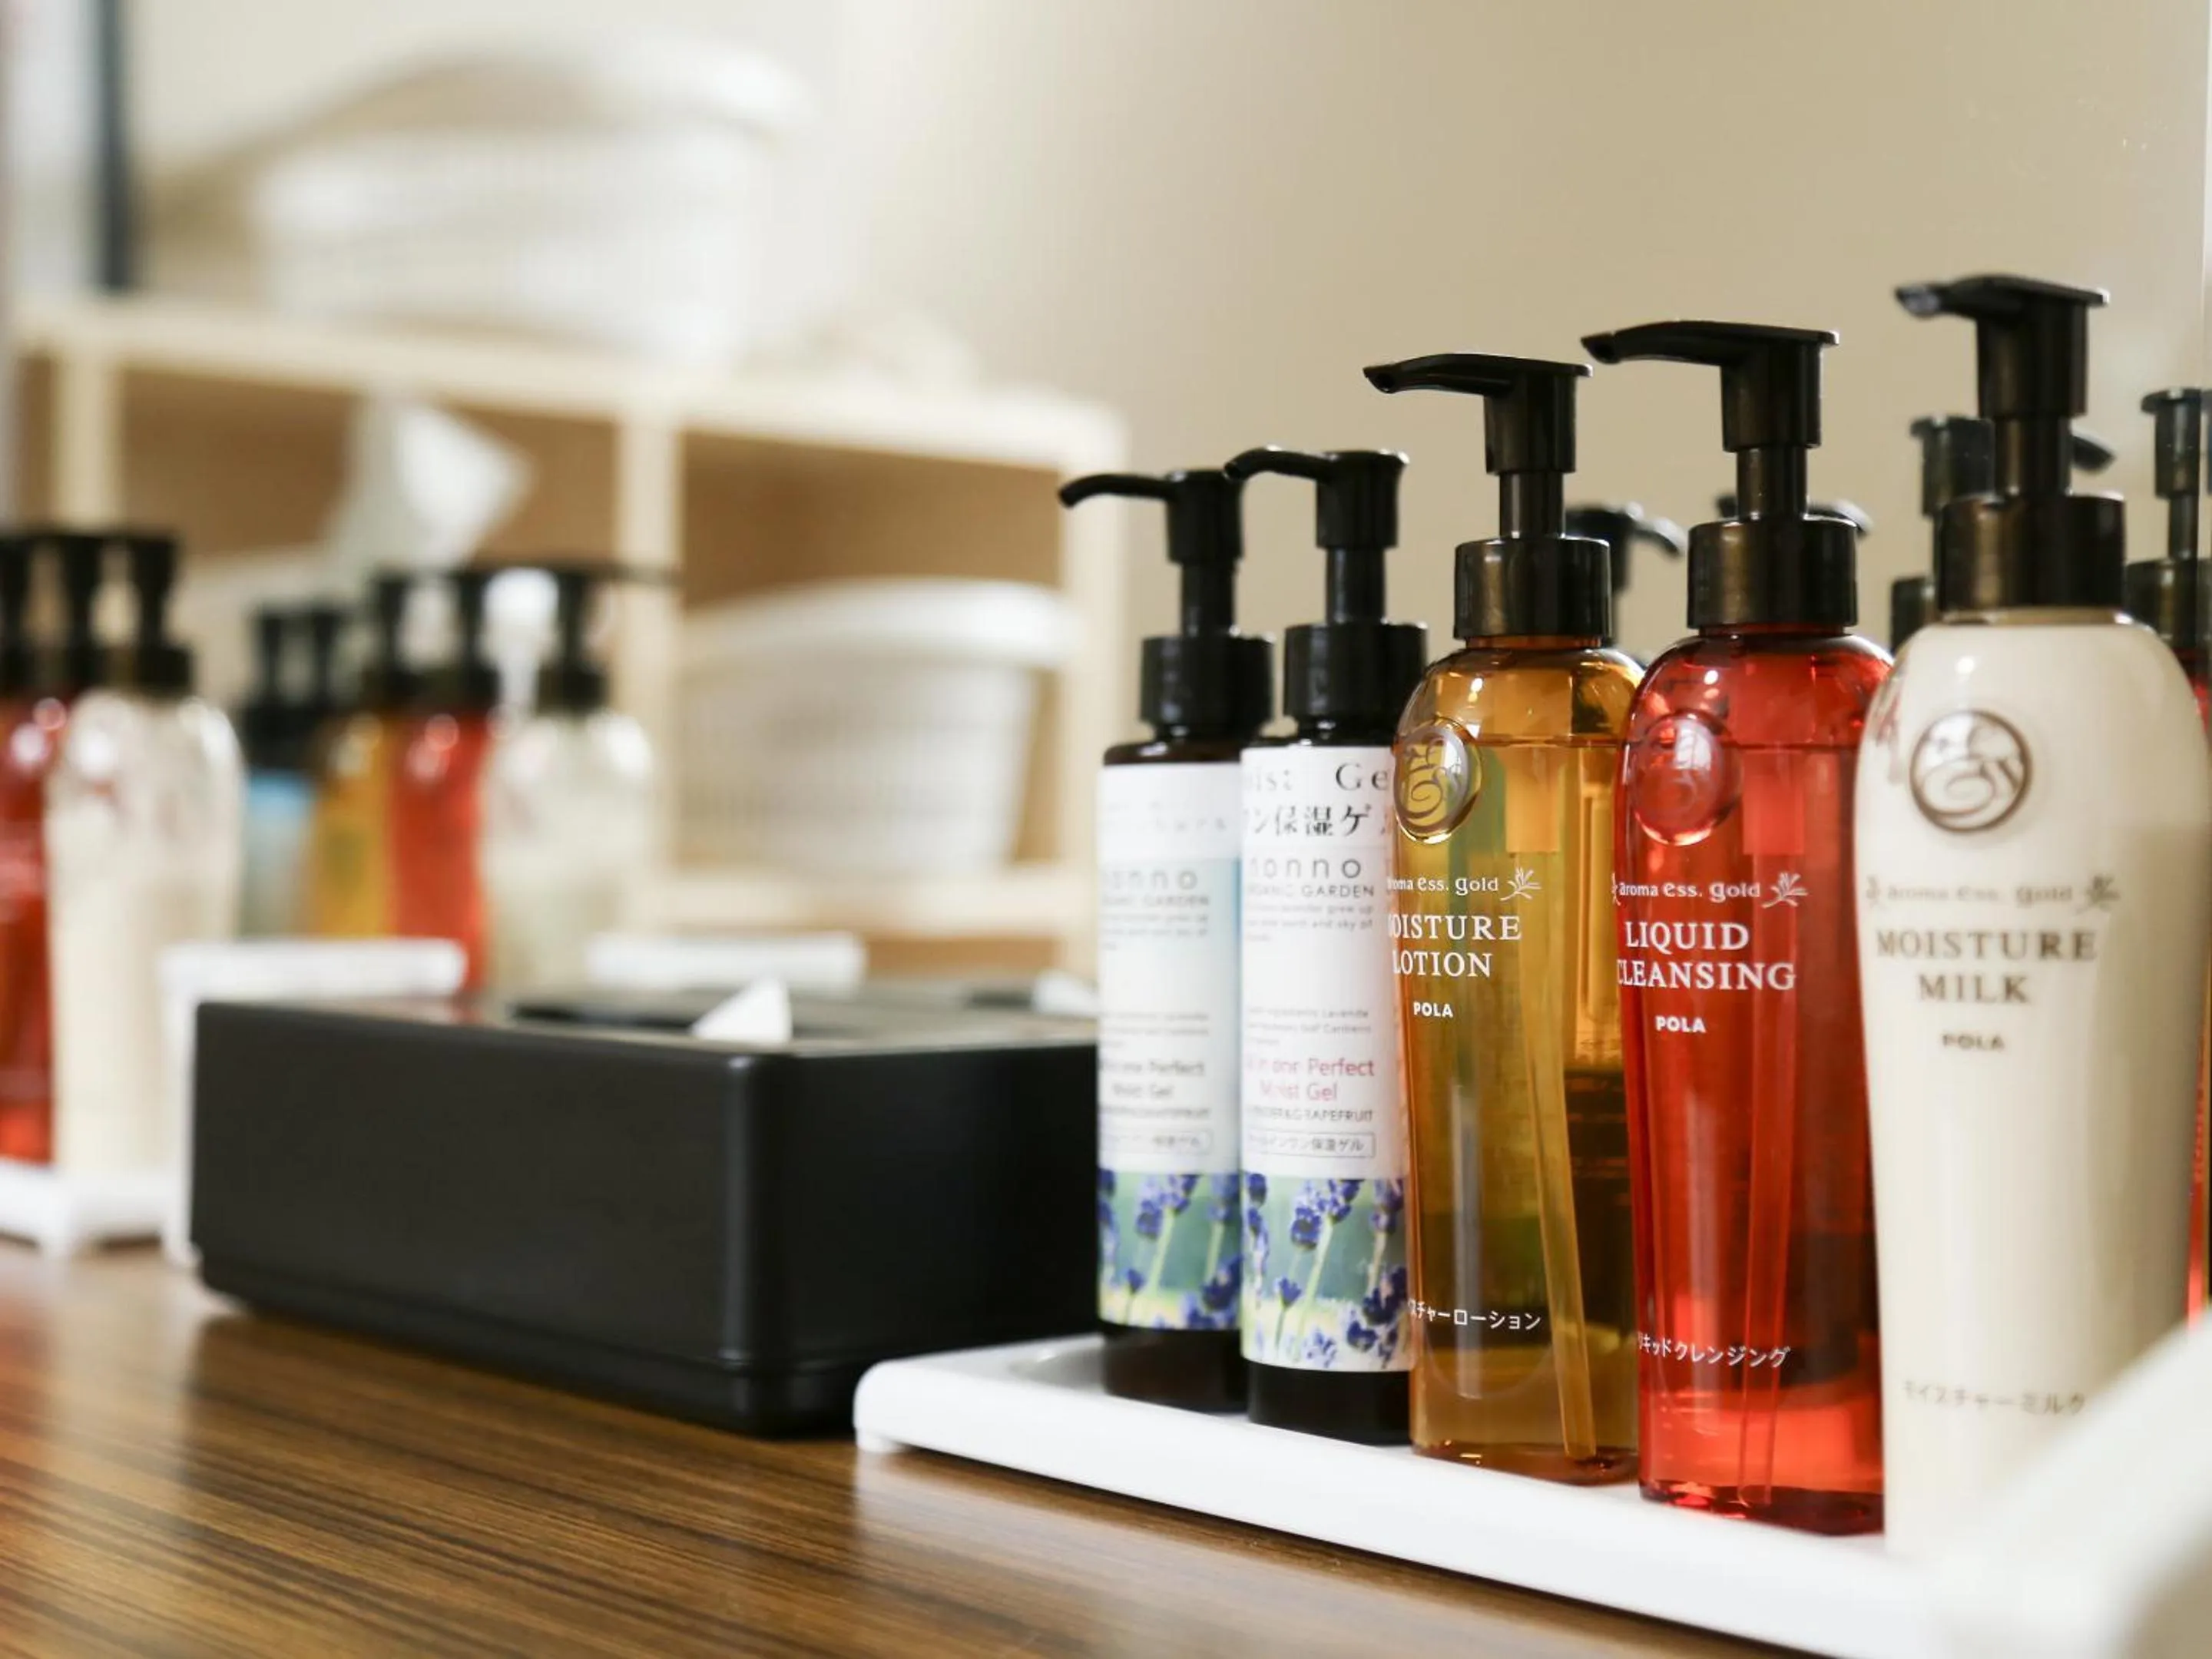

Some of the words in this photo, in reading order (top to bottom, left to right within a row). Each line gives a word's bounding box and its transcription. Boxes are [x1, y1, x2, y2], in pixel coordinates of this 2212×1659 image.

[1301, 885, 1375, 897] GARDEN
[1417, 876, 1449, 891] ess.
[1455, 876, 1498, 896] gold
[1663, 882, 1703, 897] ess.
[1709, 882, 1761, 903] gold
[1624, 921, 1750, 955] LIQUID
[1876, 929, 2098, 962] MOISTURE
[1392, 949, 1493, 978] LOTION
[1617, 959, 1796, 991] CLEANSING
[1919, 973, 2030, 1004] MILK
[1412, 1002, 1454, 1018] POLA
[1655, 1015, 1707, 1034] POLA
[1942, 1034, 2006, 1051] POLA
[1308, 1057, 1375, 1076] Perfect
[1307, 1082, 1337, 1101] Gel
